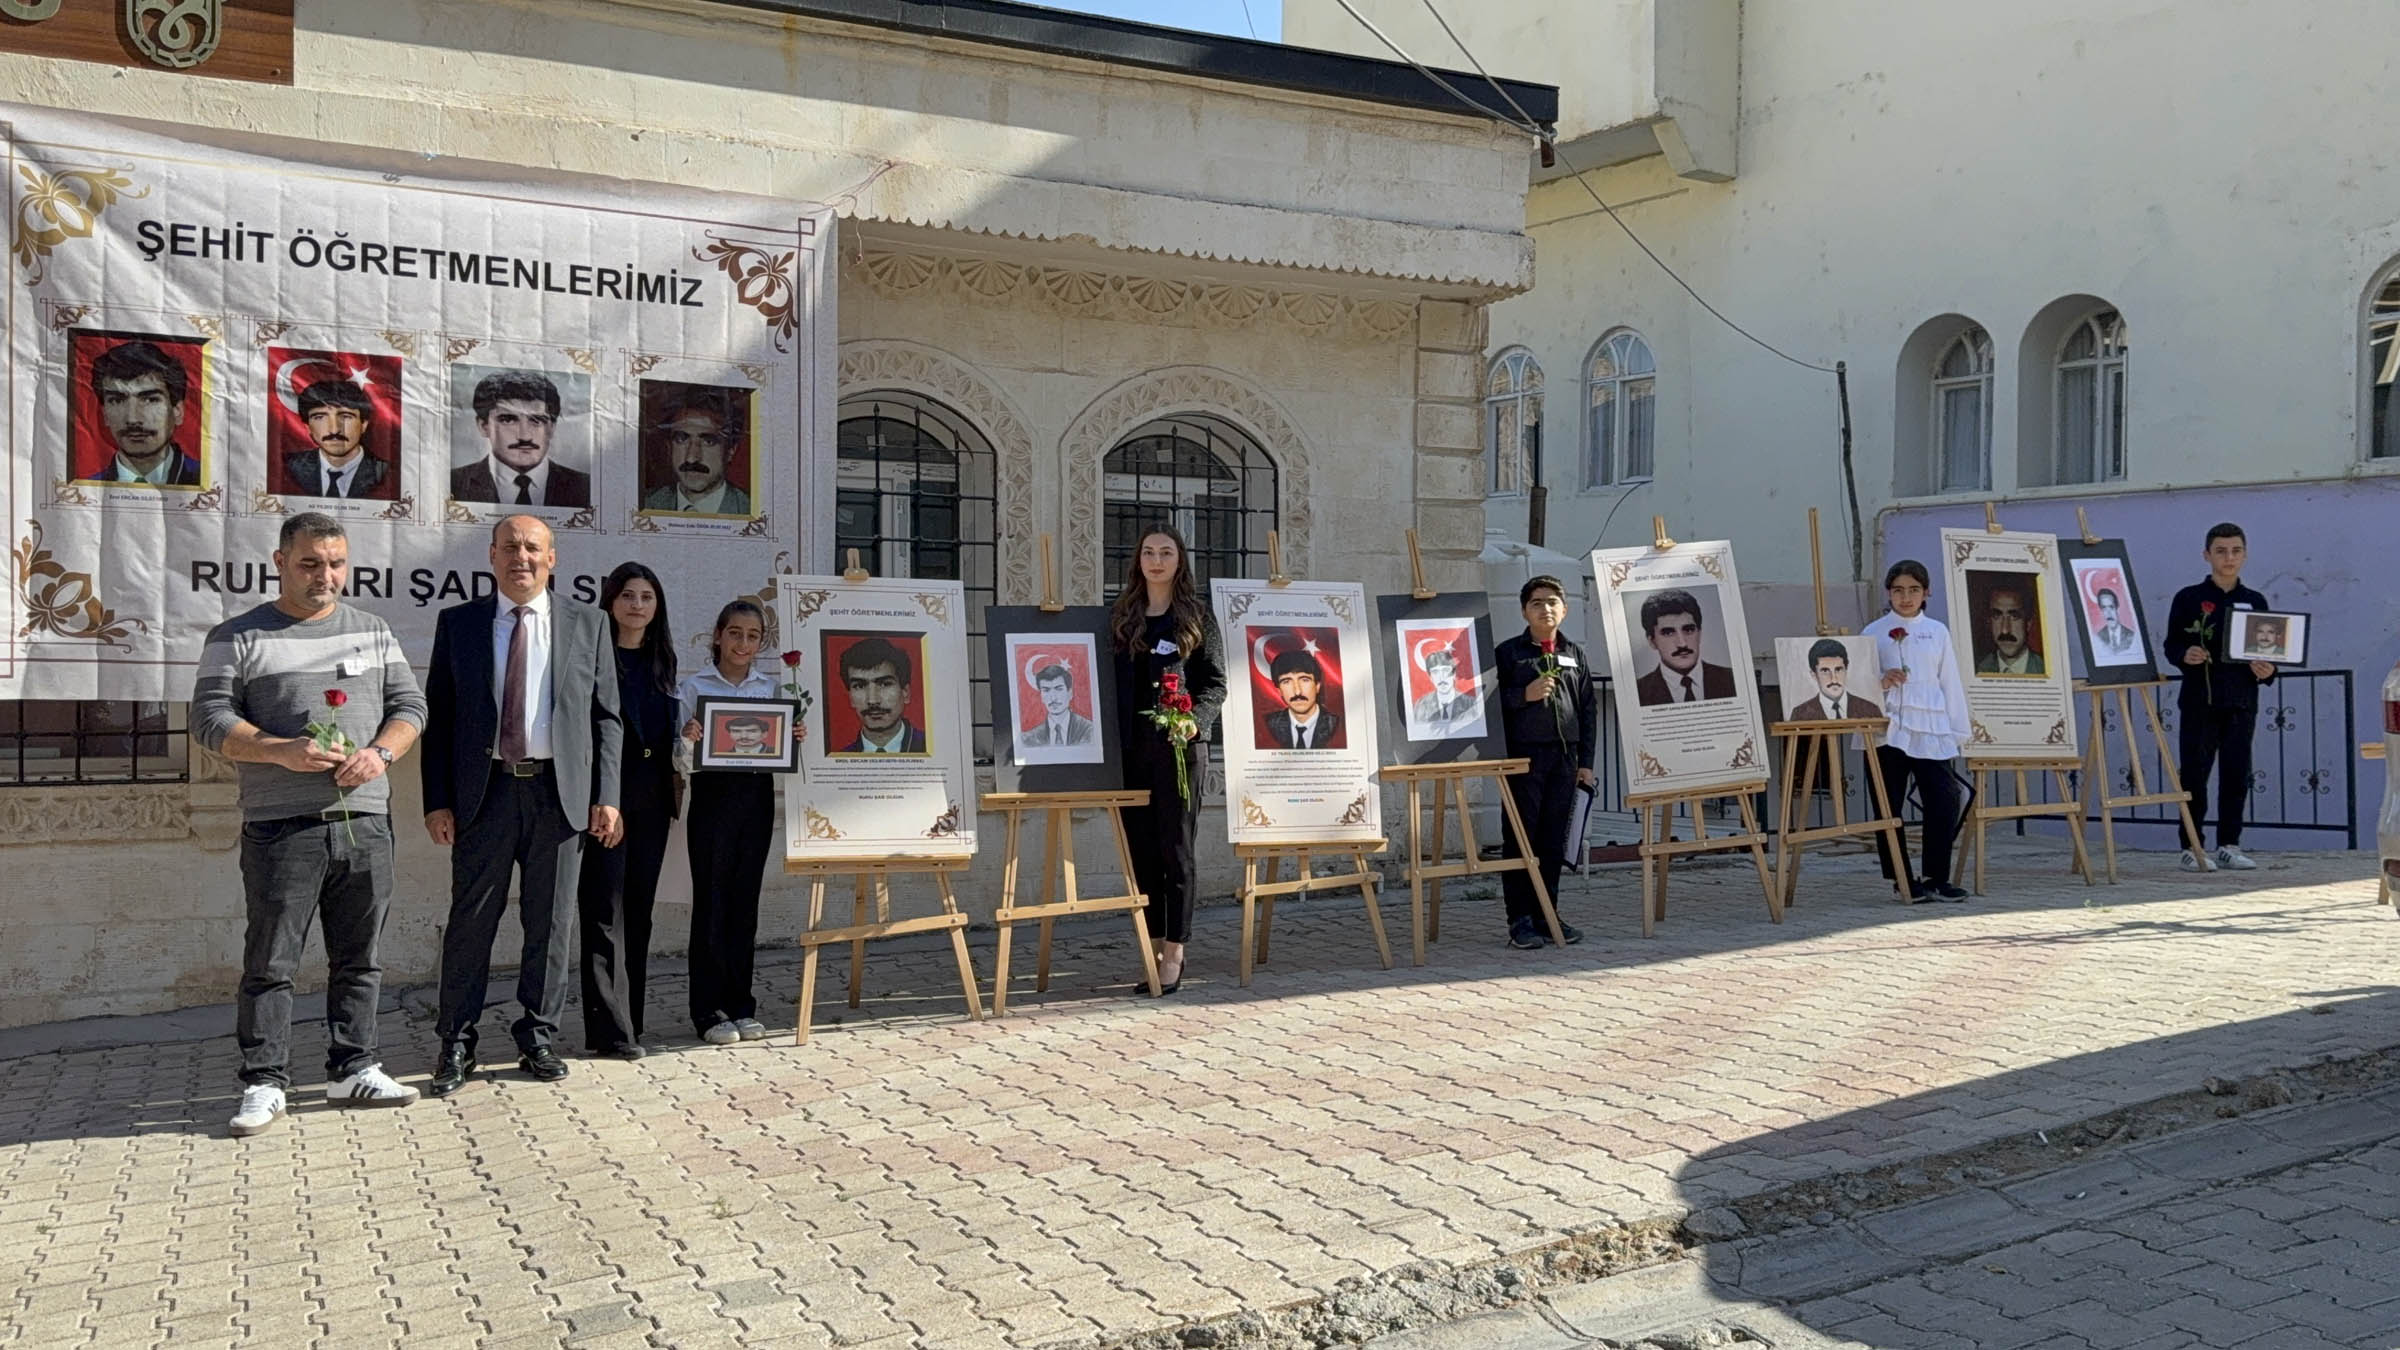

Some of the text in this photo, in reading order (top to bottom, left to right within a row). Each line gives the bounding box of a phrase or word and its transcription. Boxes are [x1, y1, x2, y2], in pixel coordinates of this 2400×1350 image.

[136, 220, 704, 308] ŞEHİT ÖĞRETMENLERİMİZ
[191, 560, 498, 608] RUHRI ŞAD
